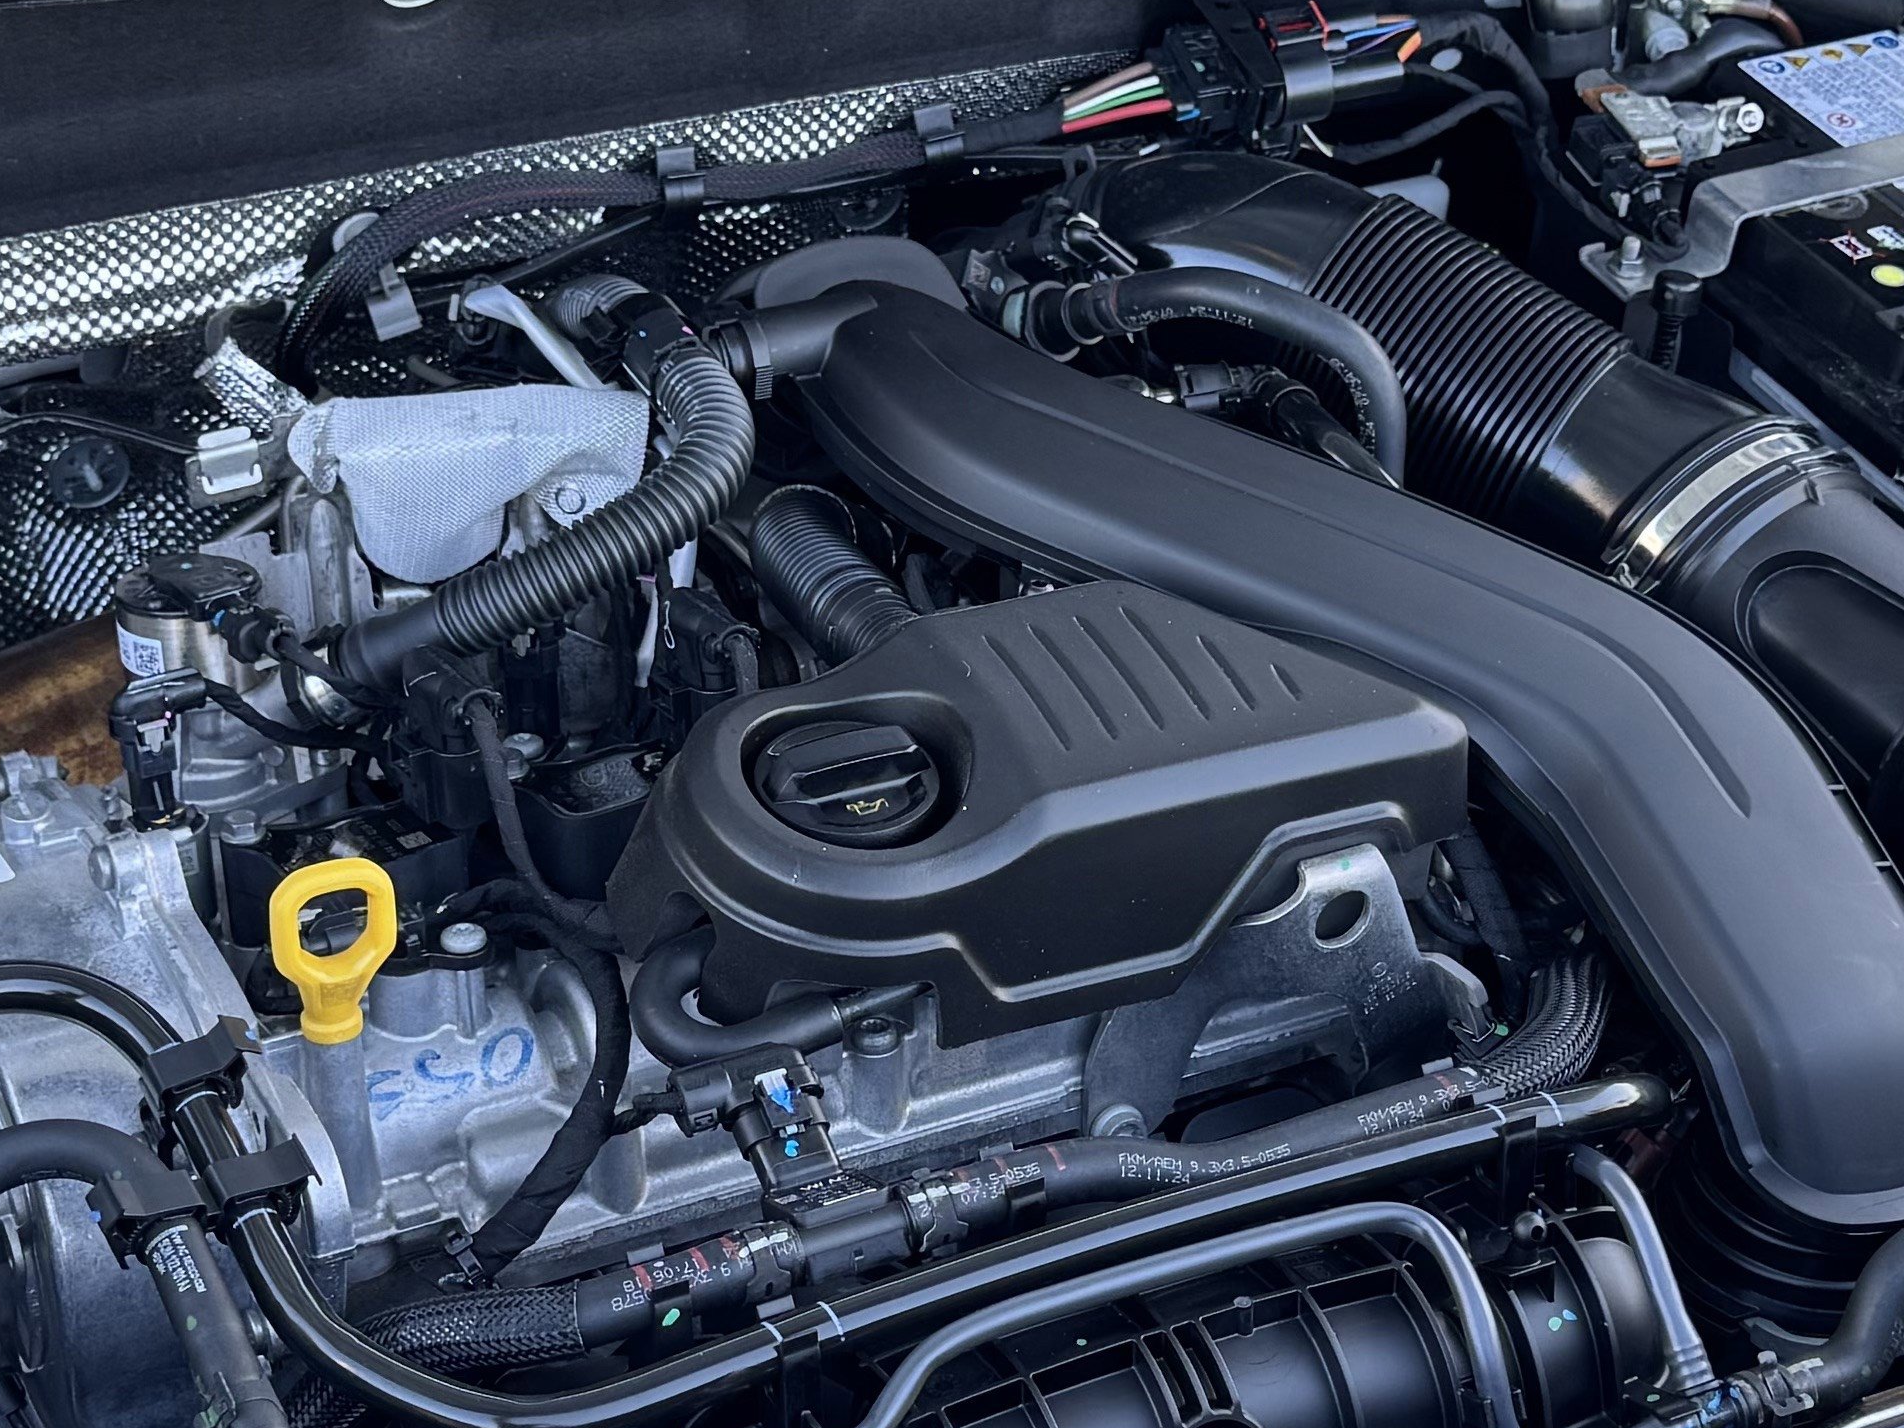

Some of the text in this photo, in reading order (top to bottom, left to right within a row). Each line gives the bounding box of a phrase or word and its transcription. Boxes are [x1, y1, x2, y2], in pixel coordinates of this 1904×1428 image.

[1118, 1144, 1291, 1175] FKM/AEM 9.3X3.5-0535
[1120, 1166, 1190, 1184] 12.11.24
